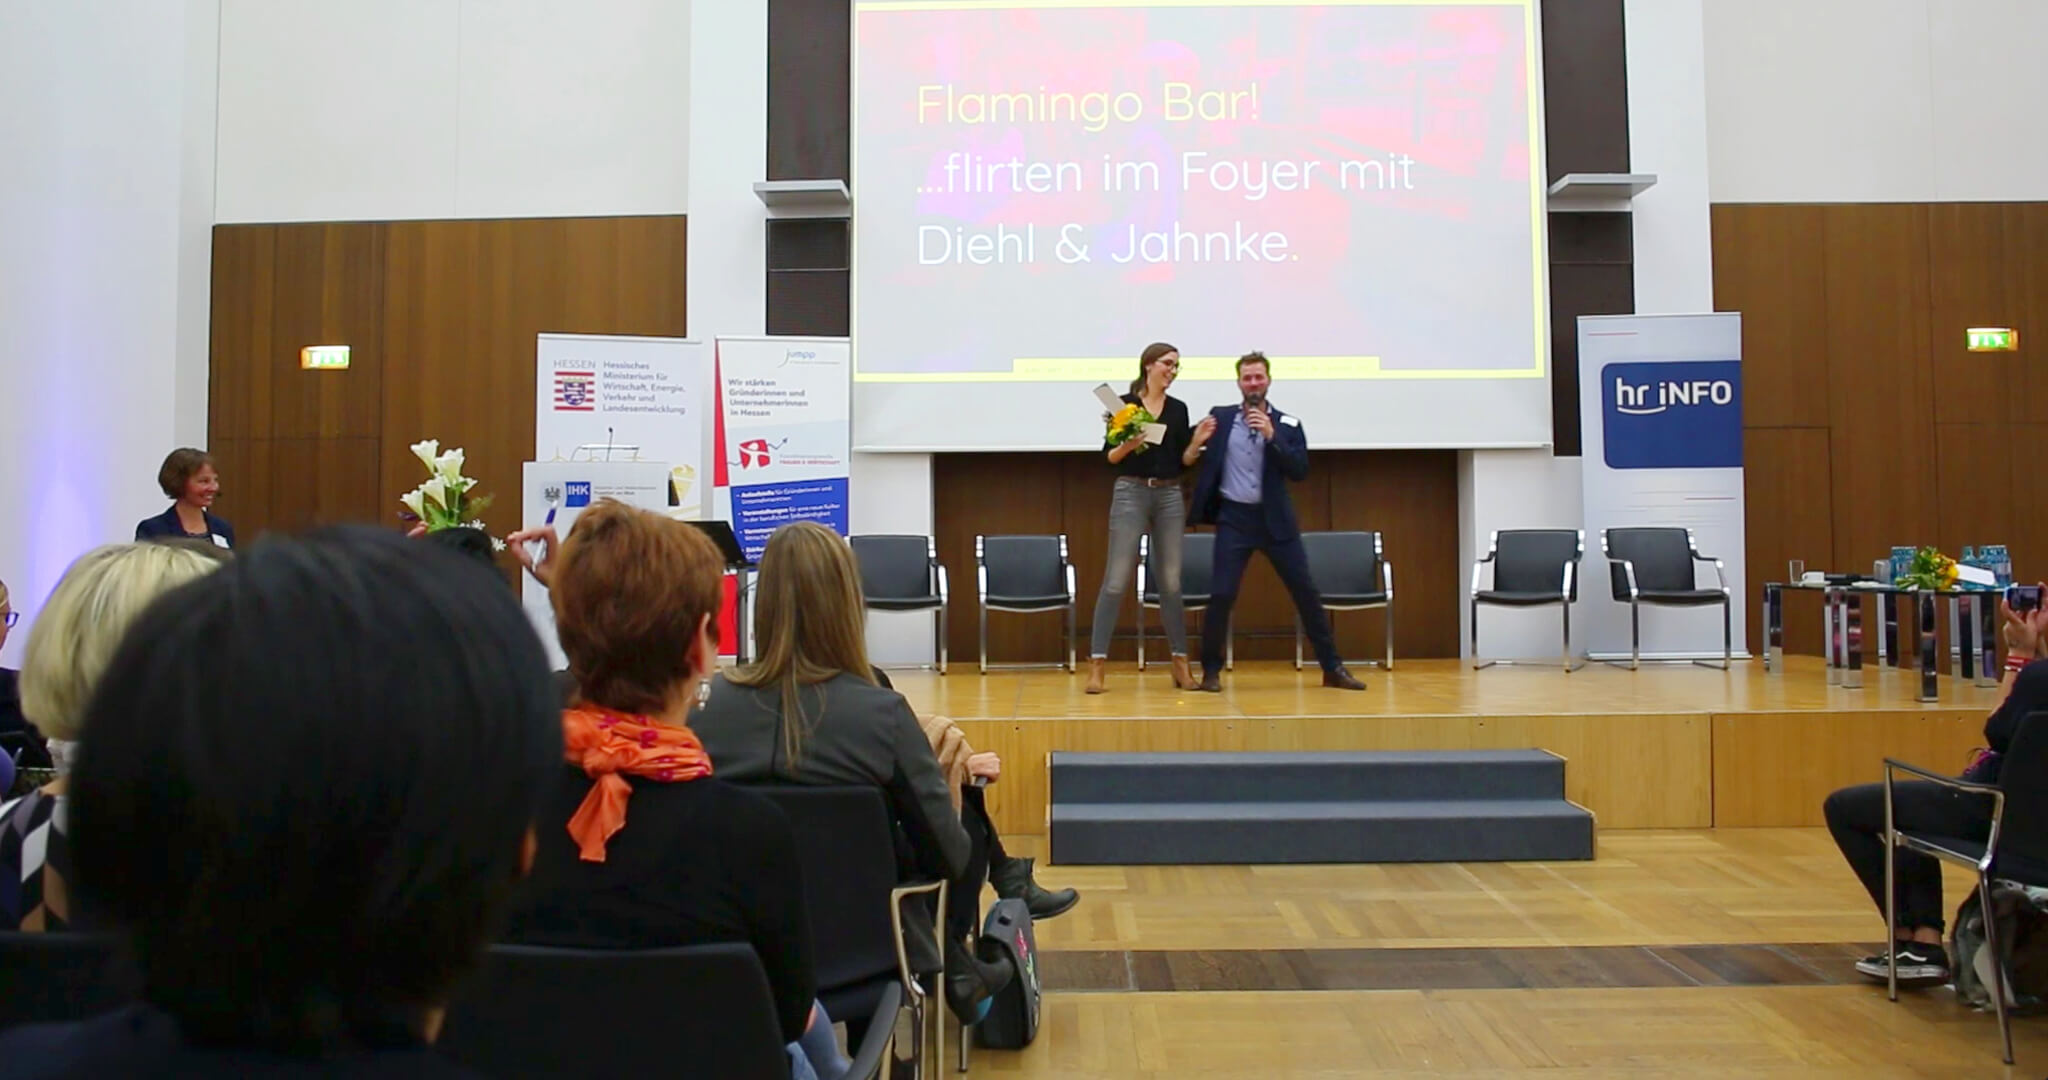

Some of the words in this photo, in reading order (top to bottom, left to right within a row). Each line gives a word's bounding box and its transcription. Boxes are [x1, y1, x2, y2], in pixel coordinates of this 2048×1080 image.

[917, 82, 1143, 132] Flamingo
[1163, 81, 1260, 122] Bar!
[915, 152, 1083, 194] ...flirten
[1103, 153, 1160, 191] im
[1182, 151, 1320, 200] Foyer
[1340, 151, 1415, 191] mit
[917, 223, 1035, 265] Diehl
[1055, 222, 1091, 264] &
[1111, 221, 1299, 264] Jahnke.
[553, 359, 596, 369] HESSEN
[603, 361, 650, 370] Hessisches
[603, 372, 654, 381] Ministerium
[656, 373, 668, 381] für
[728, 379, 743, 387] Wir
[745, 379, 777, 387] stärken
[729, 388, 787, 397] Gründerinnen
[789, 389, 806, 397] und
[1616, 377, 1650, 406] hr
[1659, 380, 1733, 406] iNFO
[603, 393, 637, 402] Verkehr
[638, 394, 655, 402] und
[602, 404, 686, 415] Landesentwicklung
[740, 409, 771, 417] Hessen
[567, 485, 590, 496] IHK
